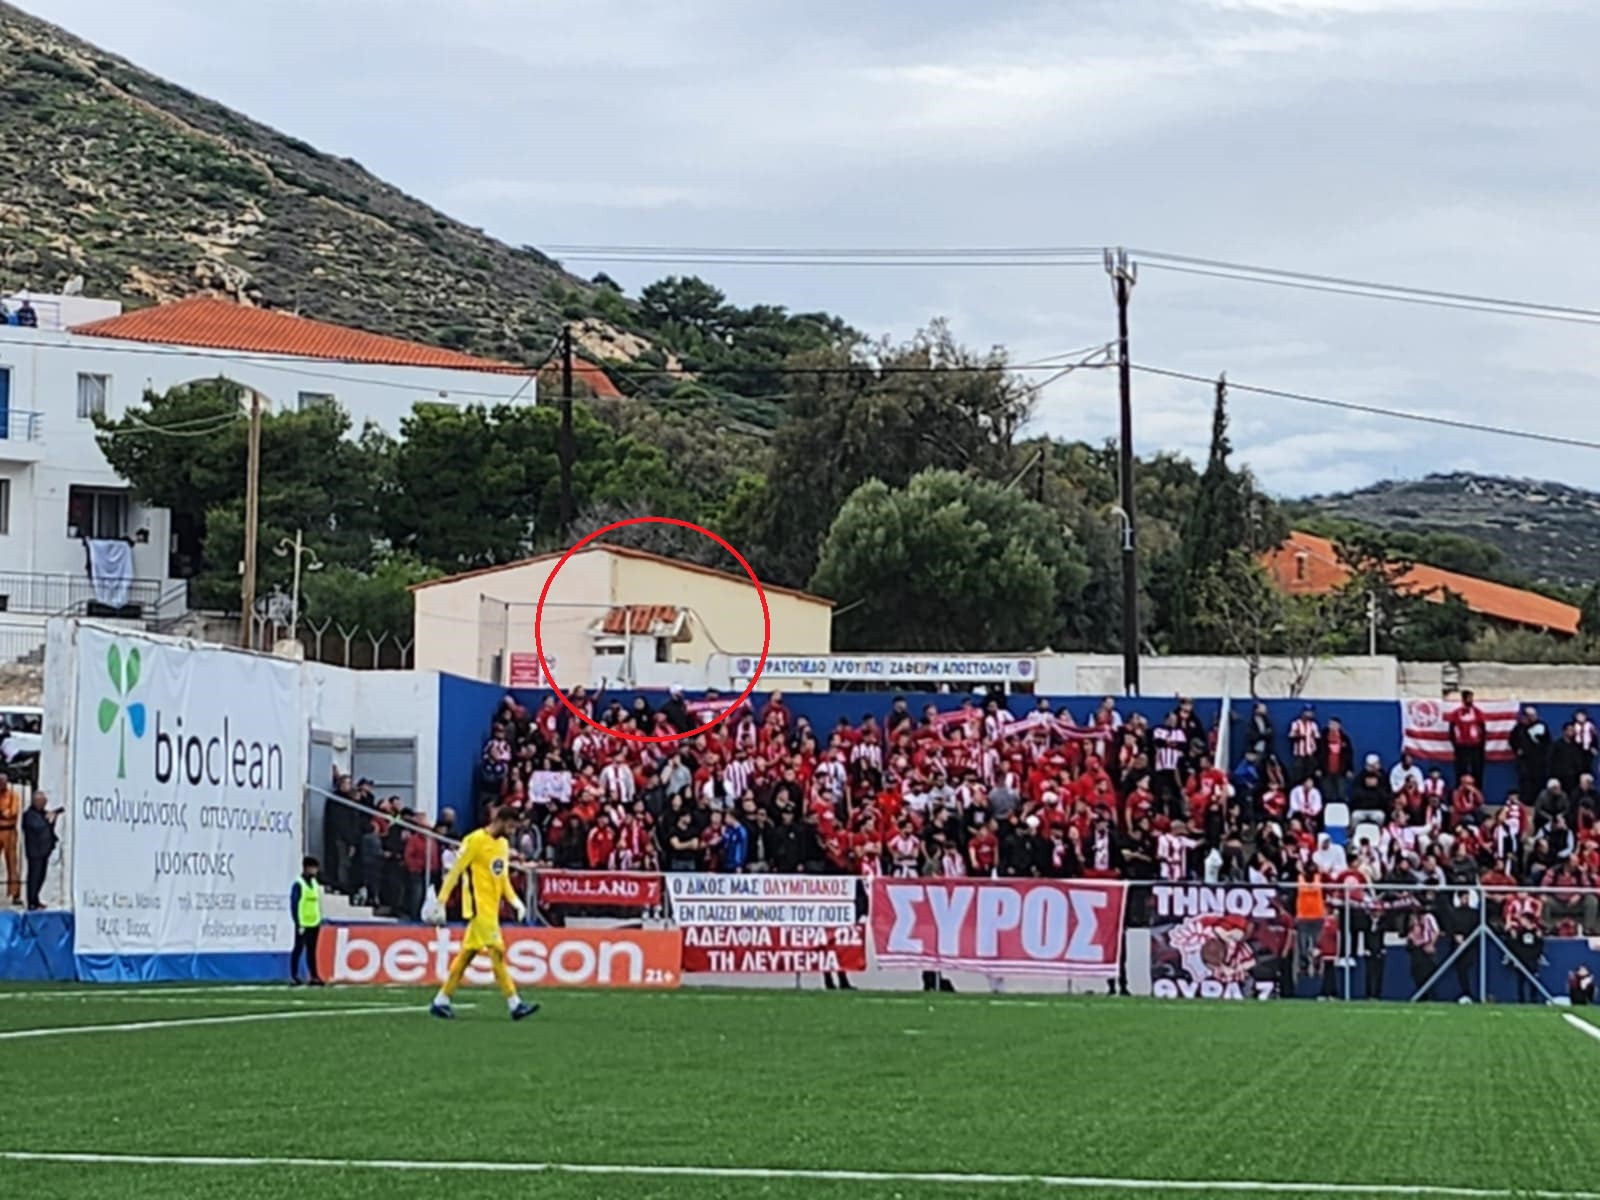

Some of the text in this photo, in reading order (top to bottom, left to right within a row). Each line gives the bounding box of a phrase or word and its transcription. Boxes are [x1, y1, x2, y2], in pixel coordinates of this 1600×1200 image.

[753, 661, 826, 674] ΣΡΑΤΟΠΕΔΟ
[942, 661, 1011, 675] ΑΠΟΣΤΟΛΟΥ
[155, 710, 282, 790] bioclean
[543, 877, 659, 898] HOLLAND 7
[673, 878, 849, 896] Ο ΔΙΚΟΣ ΜΑΣ ΟΛΥΜΠΙΑΚΟΣ
[1152, 886, 1277, 918] ΤΗΝΟΣ
[698, 905, 737, 921] ΠΑΙΖΕΙ
[741, 905, 784, 922] ΜΟΝΟΣ
[791, 905, 815, 922] ΤΟΥ
[819, 905, 851, 922] ΠΟΤΕ
[886, 884, 1108, 962] ΣΥΡΟΣ
[685, 926, 863, 947] ΑΔΕΛΦΙΑ ΓΕΡΑ ΩΣ
[332, 928, 675, 984] betsson 21+
[707, 950, 841, 972] ΤΗ ΛΕΥΤΕΡΙΑ
[1255, 981, 1274, 999] 7
